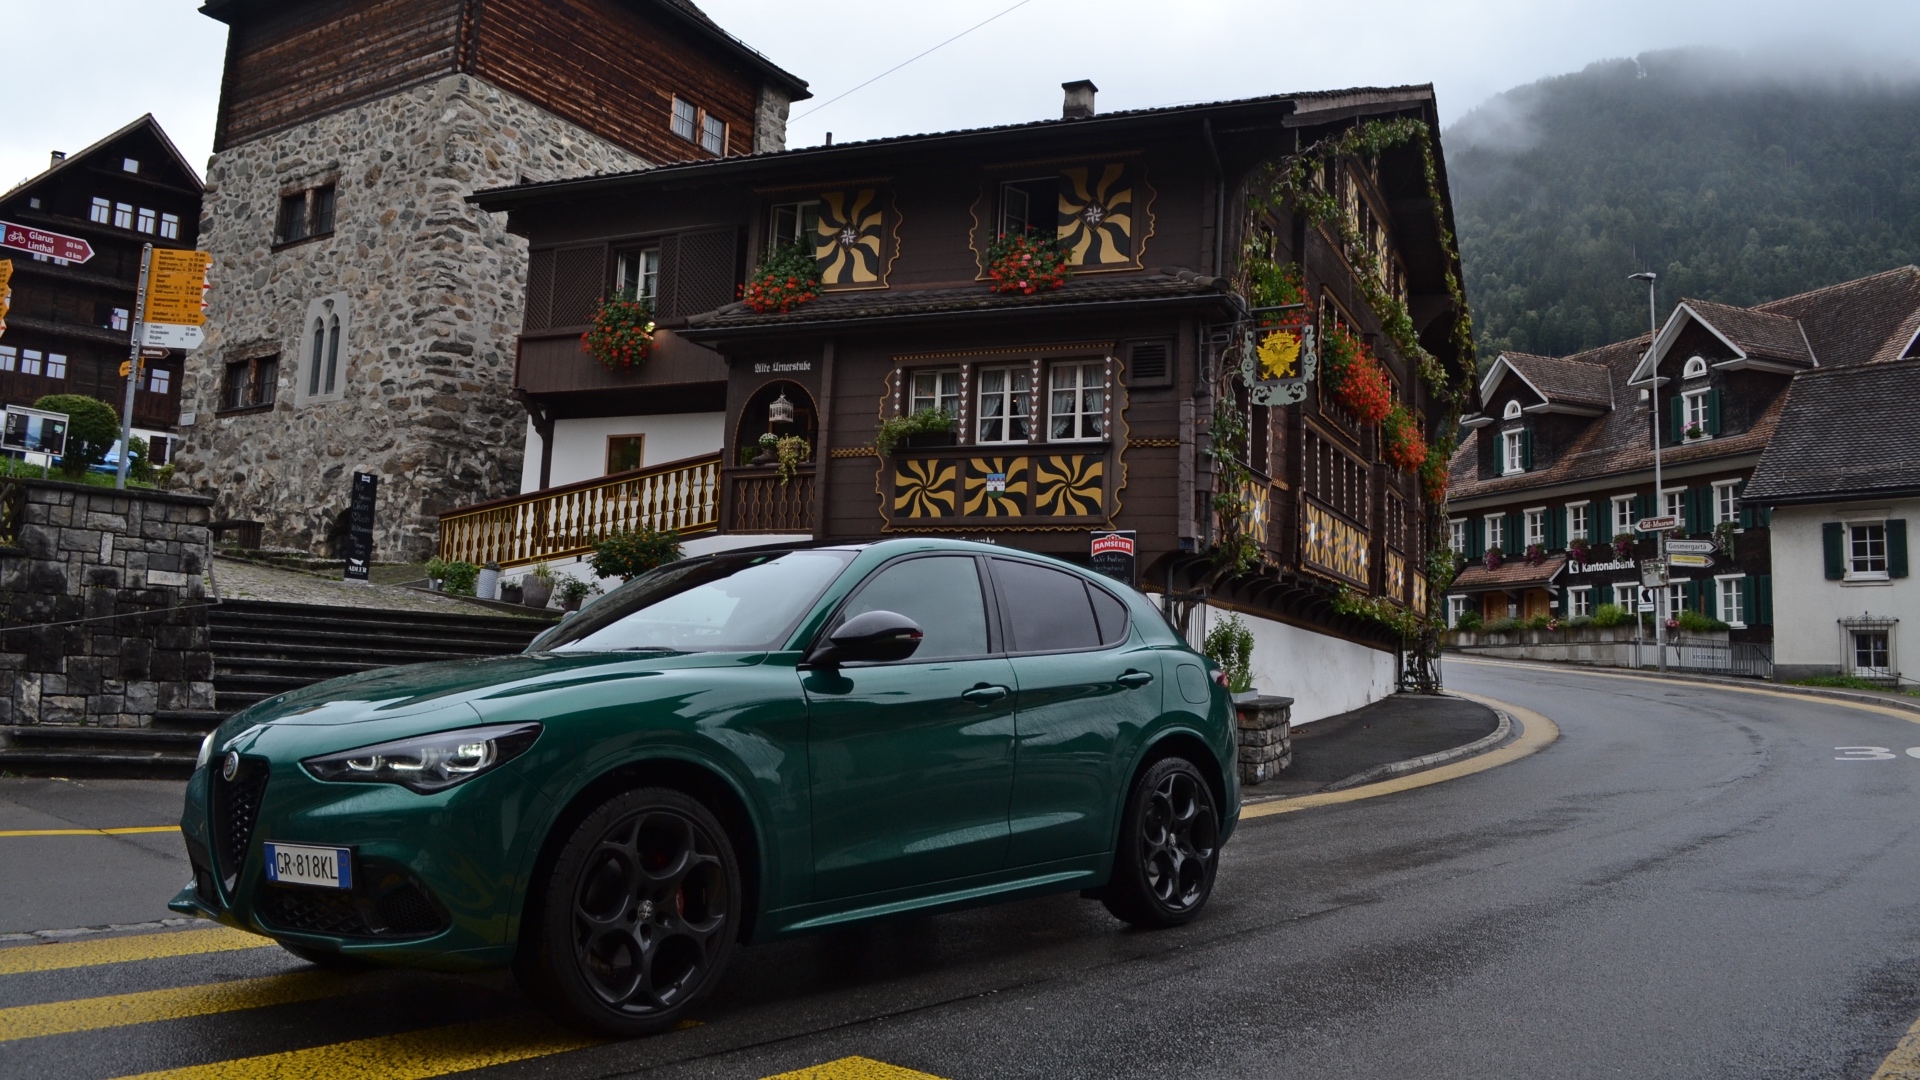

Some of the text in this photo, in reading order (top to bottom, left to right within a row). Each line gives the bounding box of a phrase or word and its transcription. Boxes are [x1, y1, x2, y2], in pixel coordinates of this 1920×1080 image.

[28, 231, 54, 244] Glarus
[74, 242, 83, 250] km
[27, 241, 55, 254] Linthal
[73, 252, 82, 260] km
[754, 360, 811, 373] Alte Urnerstube
[1642, 520, 1674, 529] Tell-Museum
[1094, 541, 1131, 550] RAMSEIER
[1668, 543, 1707, 551] Gosmergartä
[347, 565, 368, 573] ADLER
[1582, 558, 1636, 573] Kantonalbank
